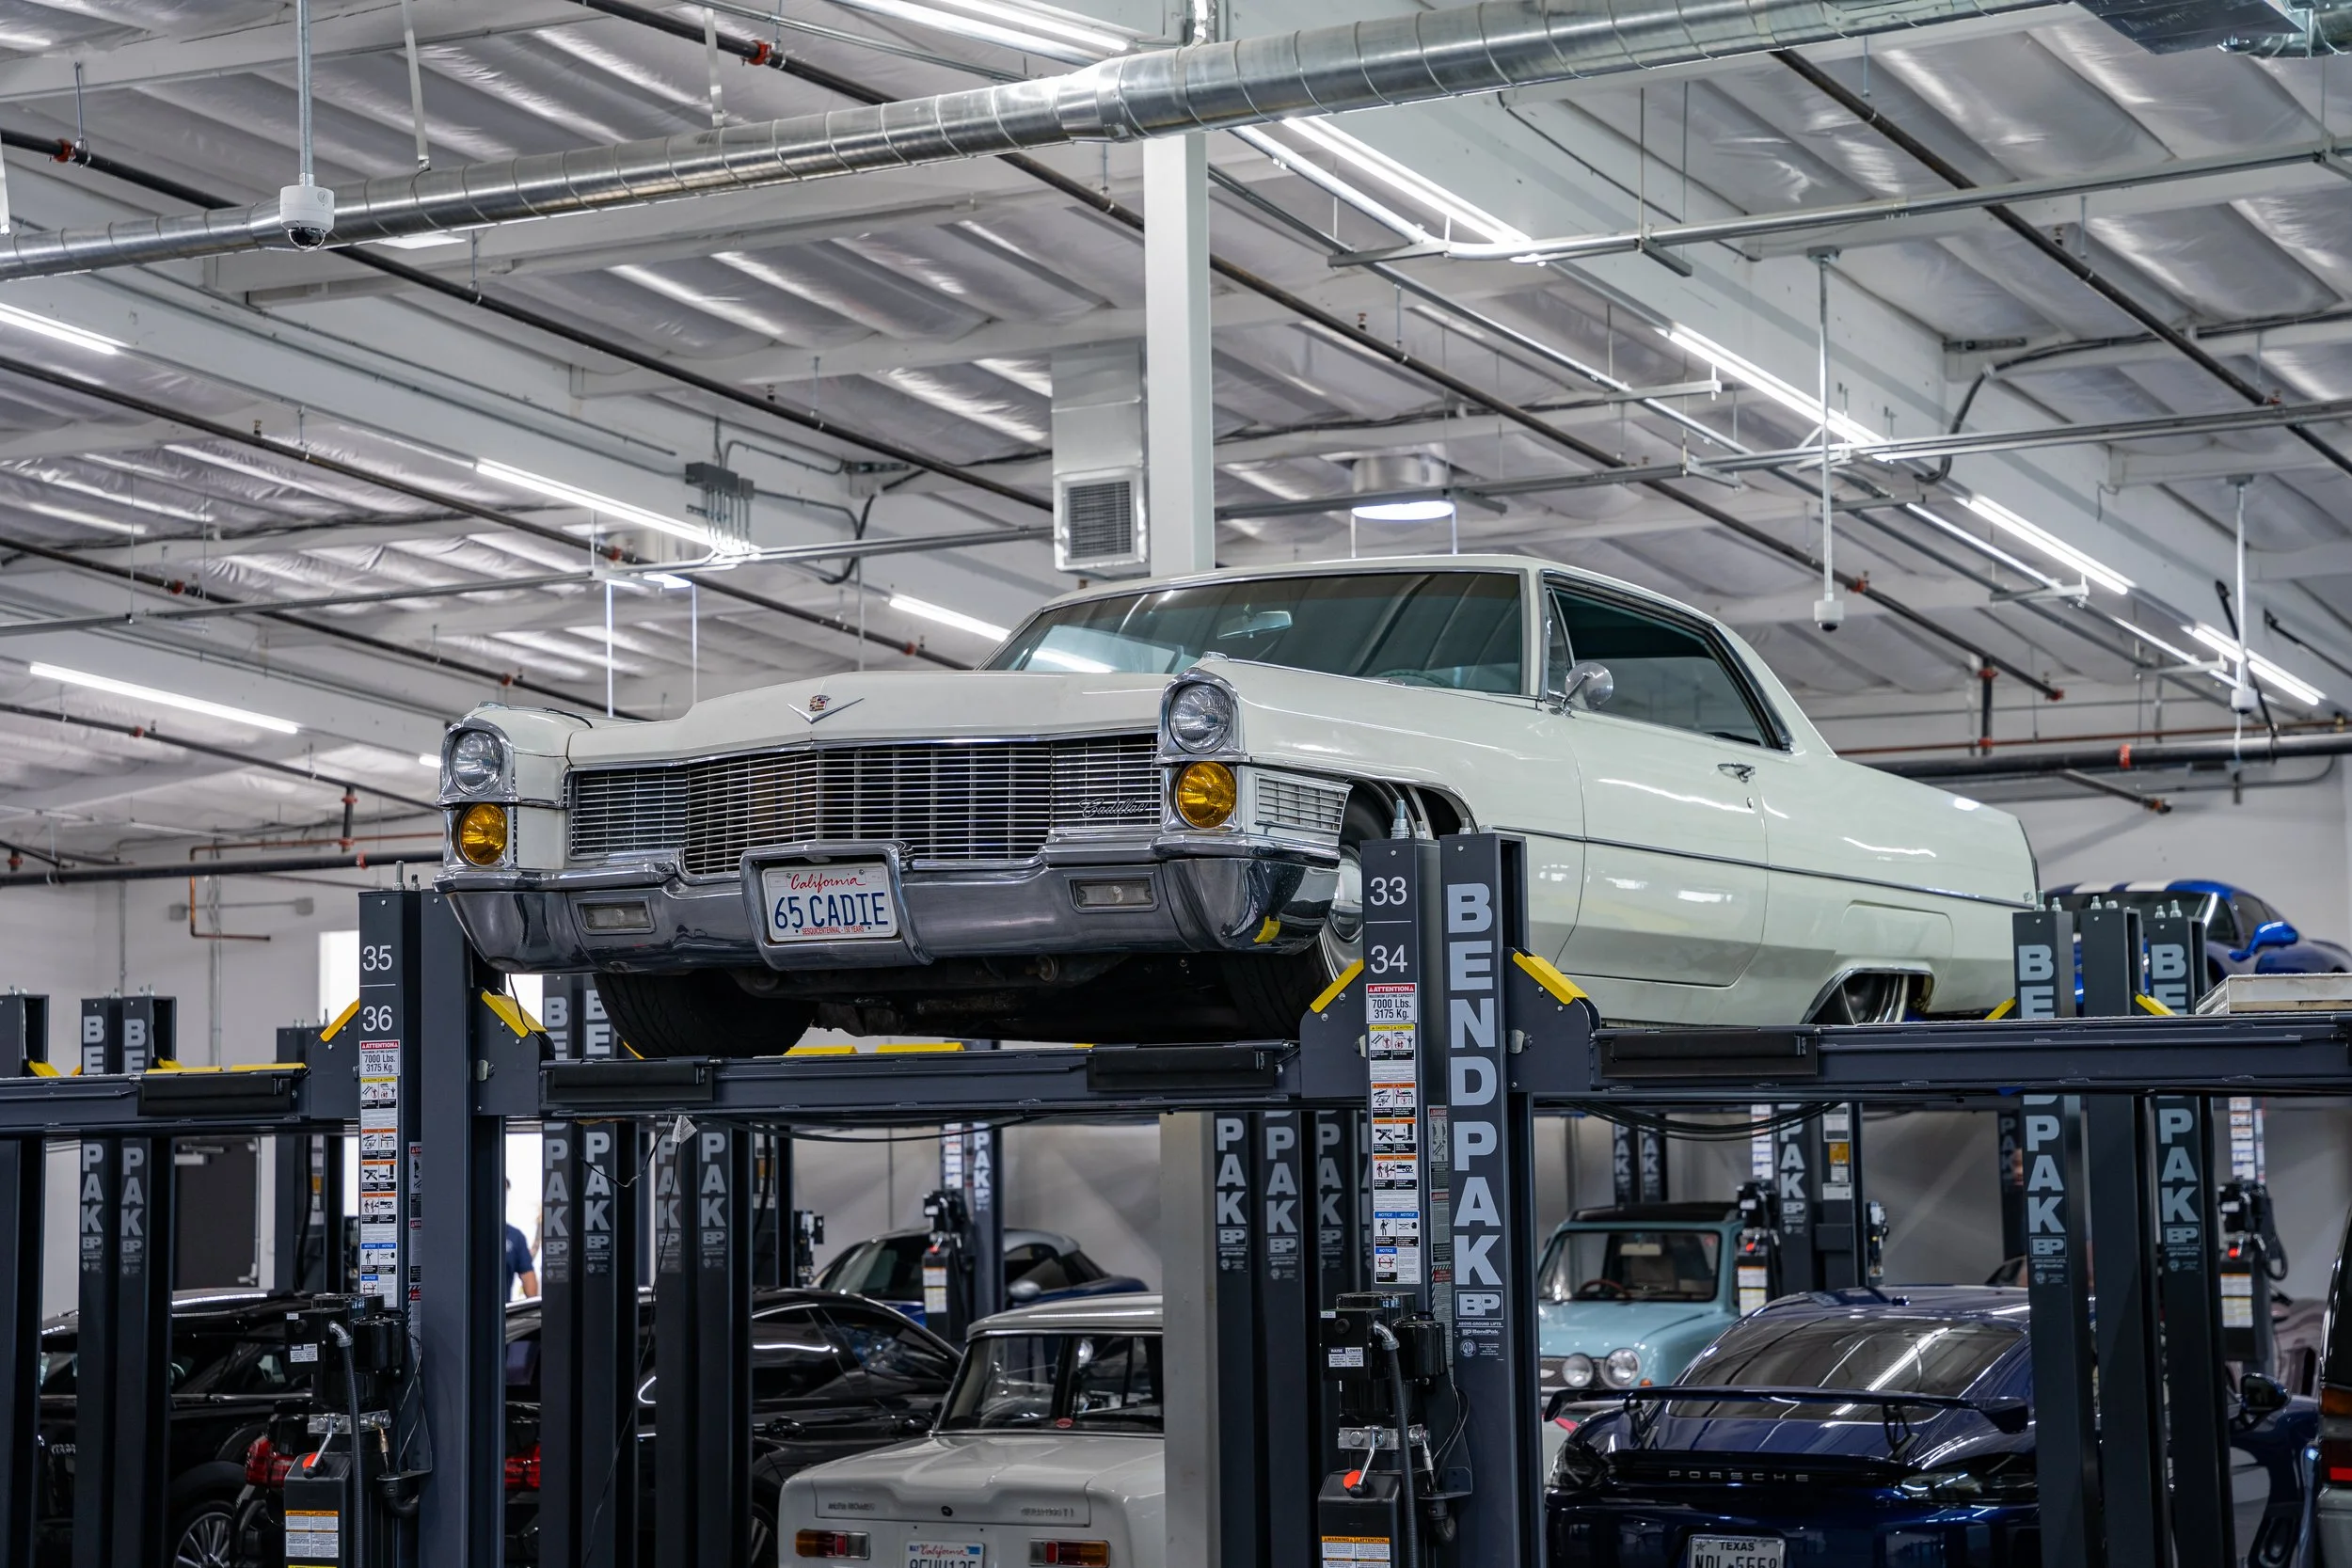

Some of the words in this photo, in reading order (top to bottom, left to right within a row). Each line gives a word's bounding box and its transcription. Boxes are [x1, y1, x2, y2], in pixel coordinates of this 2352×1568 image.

[1078, 798, 1148, 818] Cadillac
[790, 873, 866, 893] California
[1370, 876, 1407, 906] 33
[774, 895, 803, 929] 65
[809, 892, 888, 927] CADIE
[802, 926, 841, 935] SESQUICENTENNIAL
[850, 925, 865, 933] YEARS
[362, 944, 392, 971] 35
[1370, 944, 1408, 974] 34
[1372, 999, 1392, 1008] 7000
[1395, 998, 1411, 1008] Lbs.
[362, 1005, 392, 1032] 36
[1374, 1008, 1393, 1019] 3175
[1396, 1008, 1408, 1020] Kg.
[364, 1054, 380, 1063] 7000
[382, 1054, 395, 1063] Lbs.
[366, 1064, 381, 1072] 3175
[383, 1064, 393, 1072] Kg.
[1447, 882, 1502, 1285] BENDPAK
[586, 1235, 610, 1249] BP
[703, 1231, 724, 1244] BP
[1219, 1228, 1246, 1243] BP
[2166, 1227, 2198, 1243] BP
[83, 1236, 102, 1250] BP
[546, 1241, 567, 1255] BP
[1269, 1238, 1296, 1253] BP
[2032, 1238, 2064, 1255] BP
[1459, 1294, 1501, 1316] BP
[1668, 1470, 1809, 1481] PORSCHE
[920, 1544, 968, 1558] California
[1719, 1541, 1755, 1552] TEXAS
